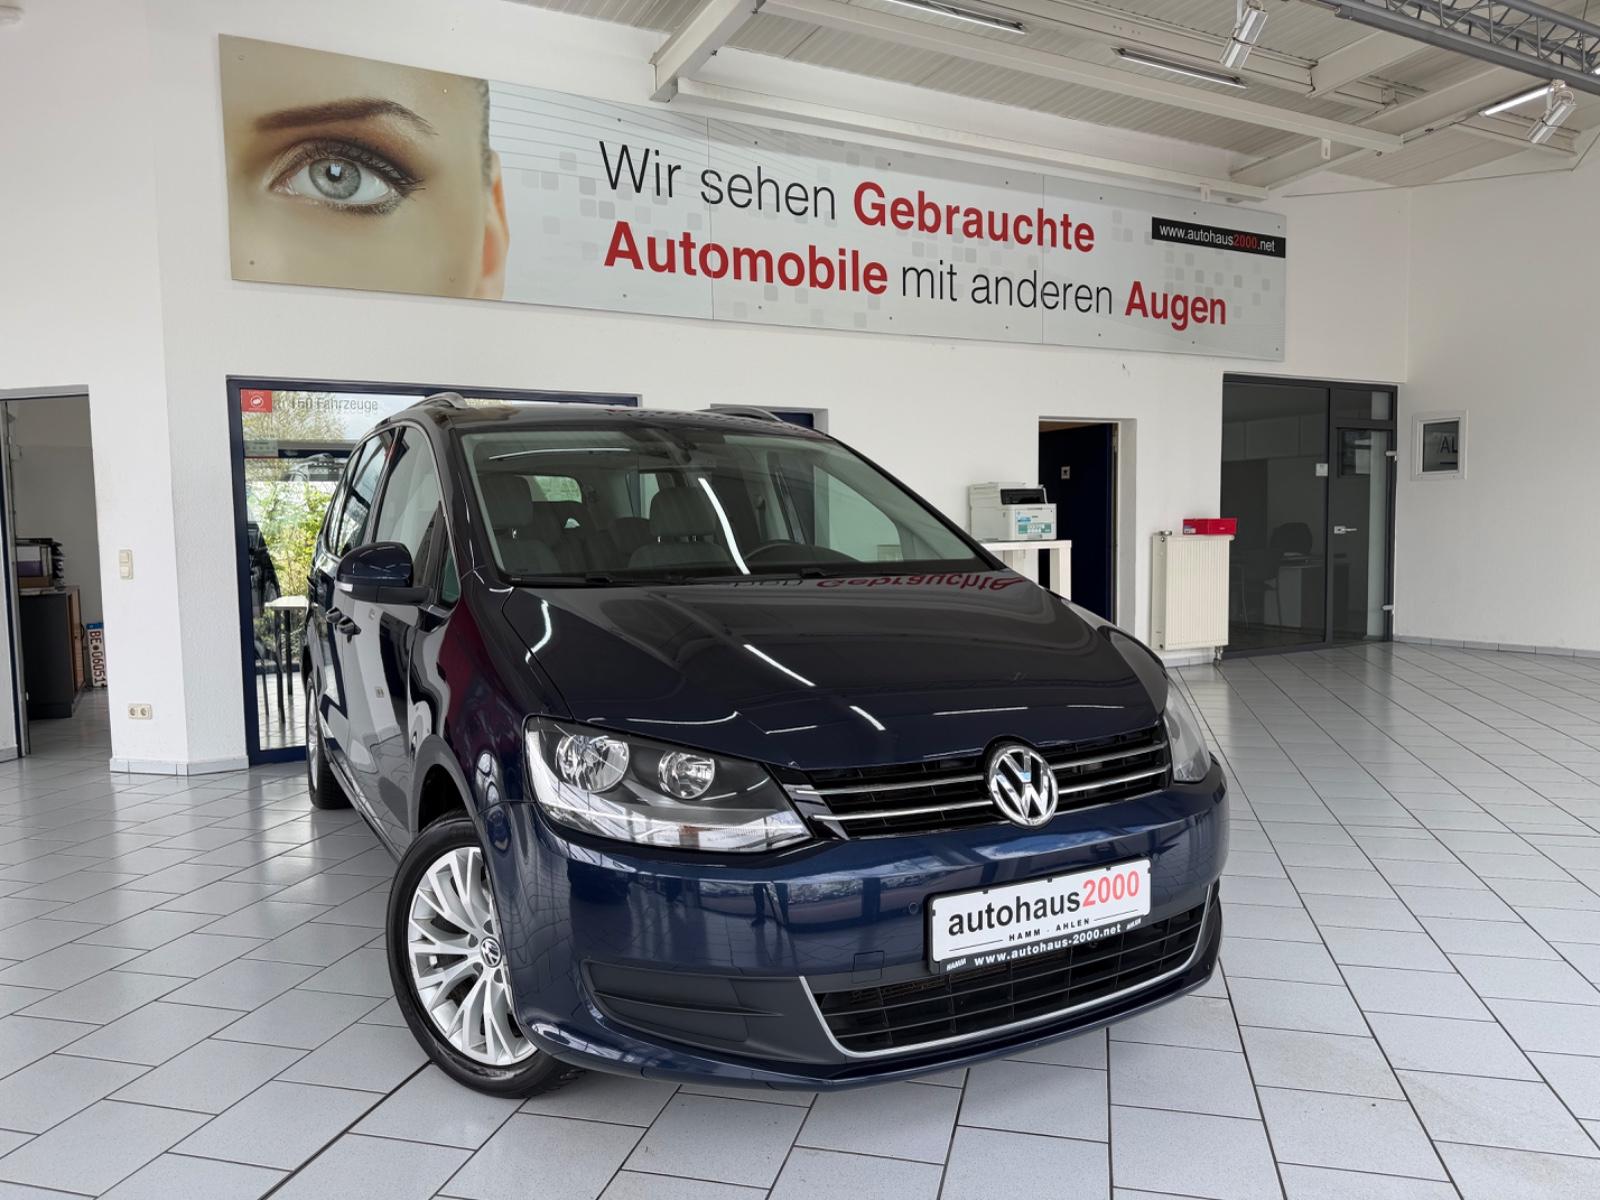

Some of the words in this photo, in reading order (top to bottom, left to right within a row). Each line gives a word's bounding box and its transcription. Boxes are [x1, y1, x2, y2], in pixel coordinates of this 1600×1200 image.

[599, 141, 681, 198] Wir
[700, 166, 835, 220] sehen
[853, 181, 1095, 252] Gebrauchte
[1160, 225, 1275, 252] www.autohaus2000.net
[604, 220, 888, 295] Automobile
[901, 260, 958, 302] mit
[971, 270, 1113, 315] anderen
[1125, 281, 1227, 331] Augen
[315, 398, 378, 412] Fahrzeuge
[948, 870, 1140, 936] autohaus2000
[974, 924, 1122, 967] www.autohaus-2000.net
[1009, 929, 1041, 941] HAMM
[1056, 918, 1090, 931] AHLEN
